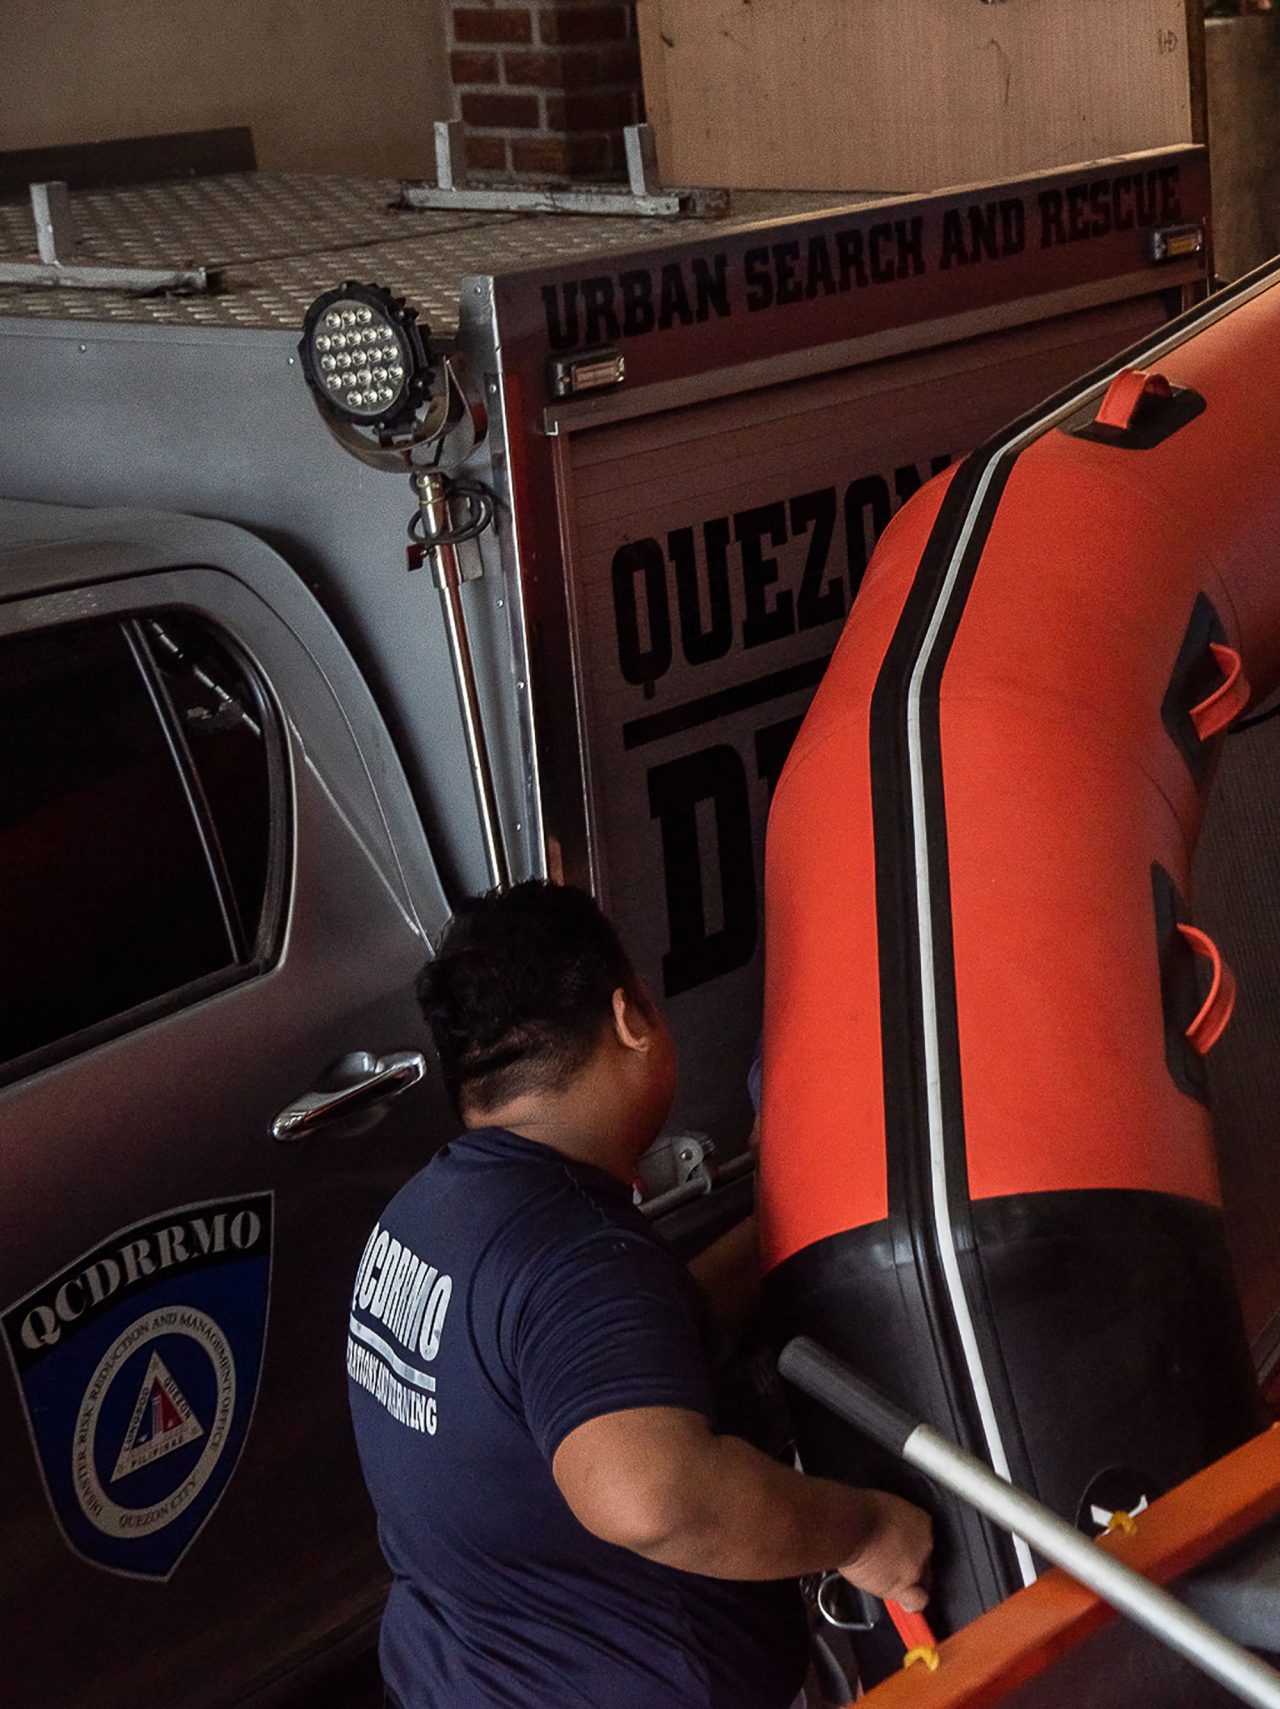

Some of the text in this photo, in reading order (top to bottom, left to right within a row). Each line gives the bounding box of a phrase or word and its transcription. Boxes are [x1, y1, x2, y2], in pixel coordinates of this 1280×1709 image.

[540, 165, 1183, 351] URBAN SEARCH AND RESCUE
[612, 454, 952, 699] QUEZO
[20, 1210, 261, 1350] QCDRRMO
[78, 1405, 94, 1444] RISK
[90, 1322, 150, 1401] REDUCTION
[151, 1312, 177, 1332] AND
[179, 1313, 232, 1396] MANAGEMENT
[119, 1504, 169, 1529] QUEZON
